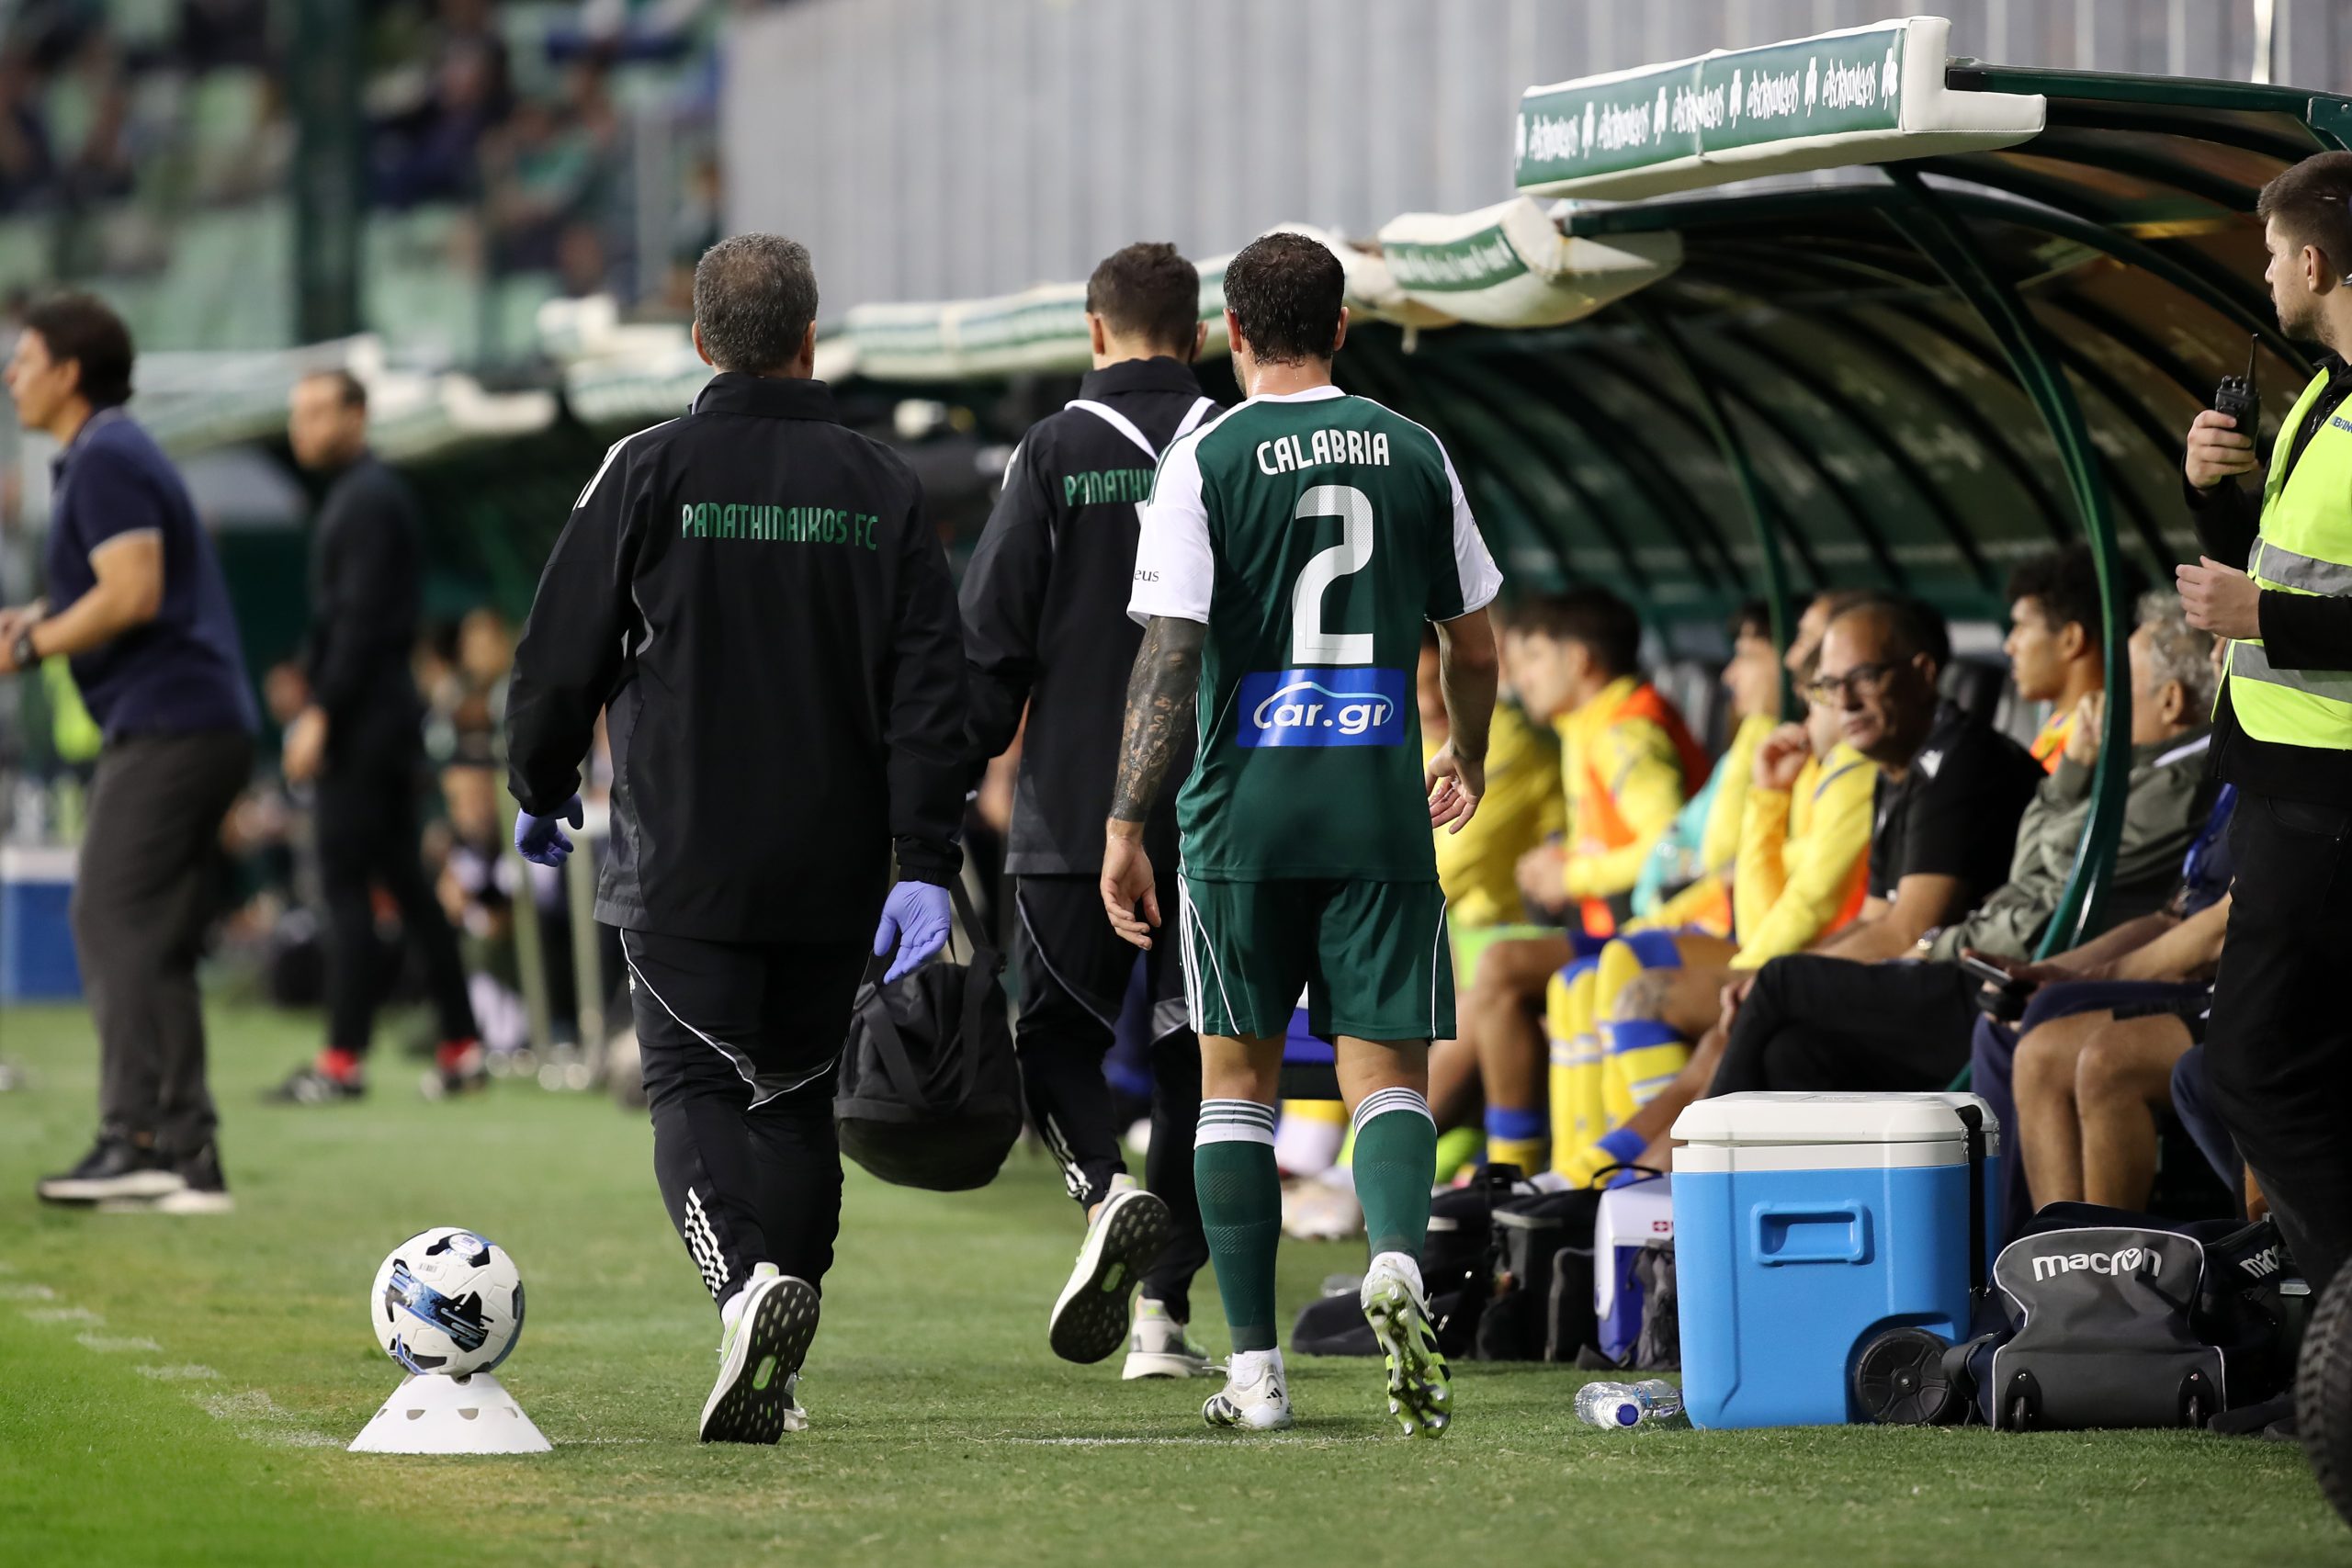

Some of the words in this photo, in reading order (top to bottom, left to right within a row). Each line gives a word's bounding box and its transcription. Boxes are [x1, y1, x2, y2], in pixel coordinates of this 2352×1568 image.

[1257, 429, 1389, 476] CALABRIA
[681, 502, 848, 545] PANATHINAIKOS
[854, 513, 879, 551] FC
[1292, 484, 1374, 665] 2
[1252, 689, 1389, 735] car.gr
[2031, 1247, 2163, 1282] macron
